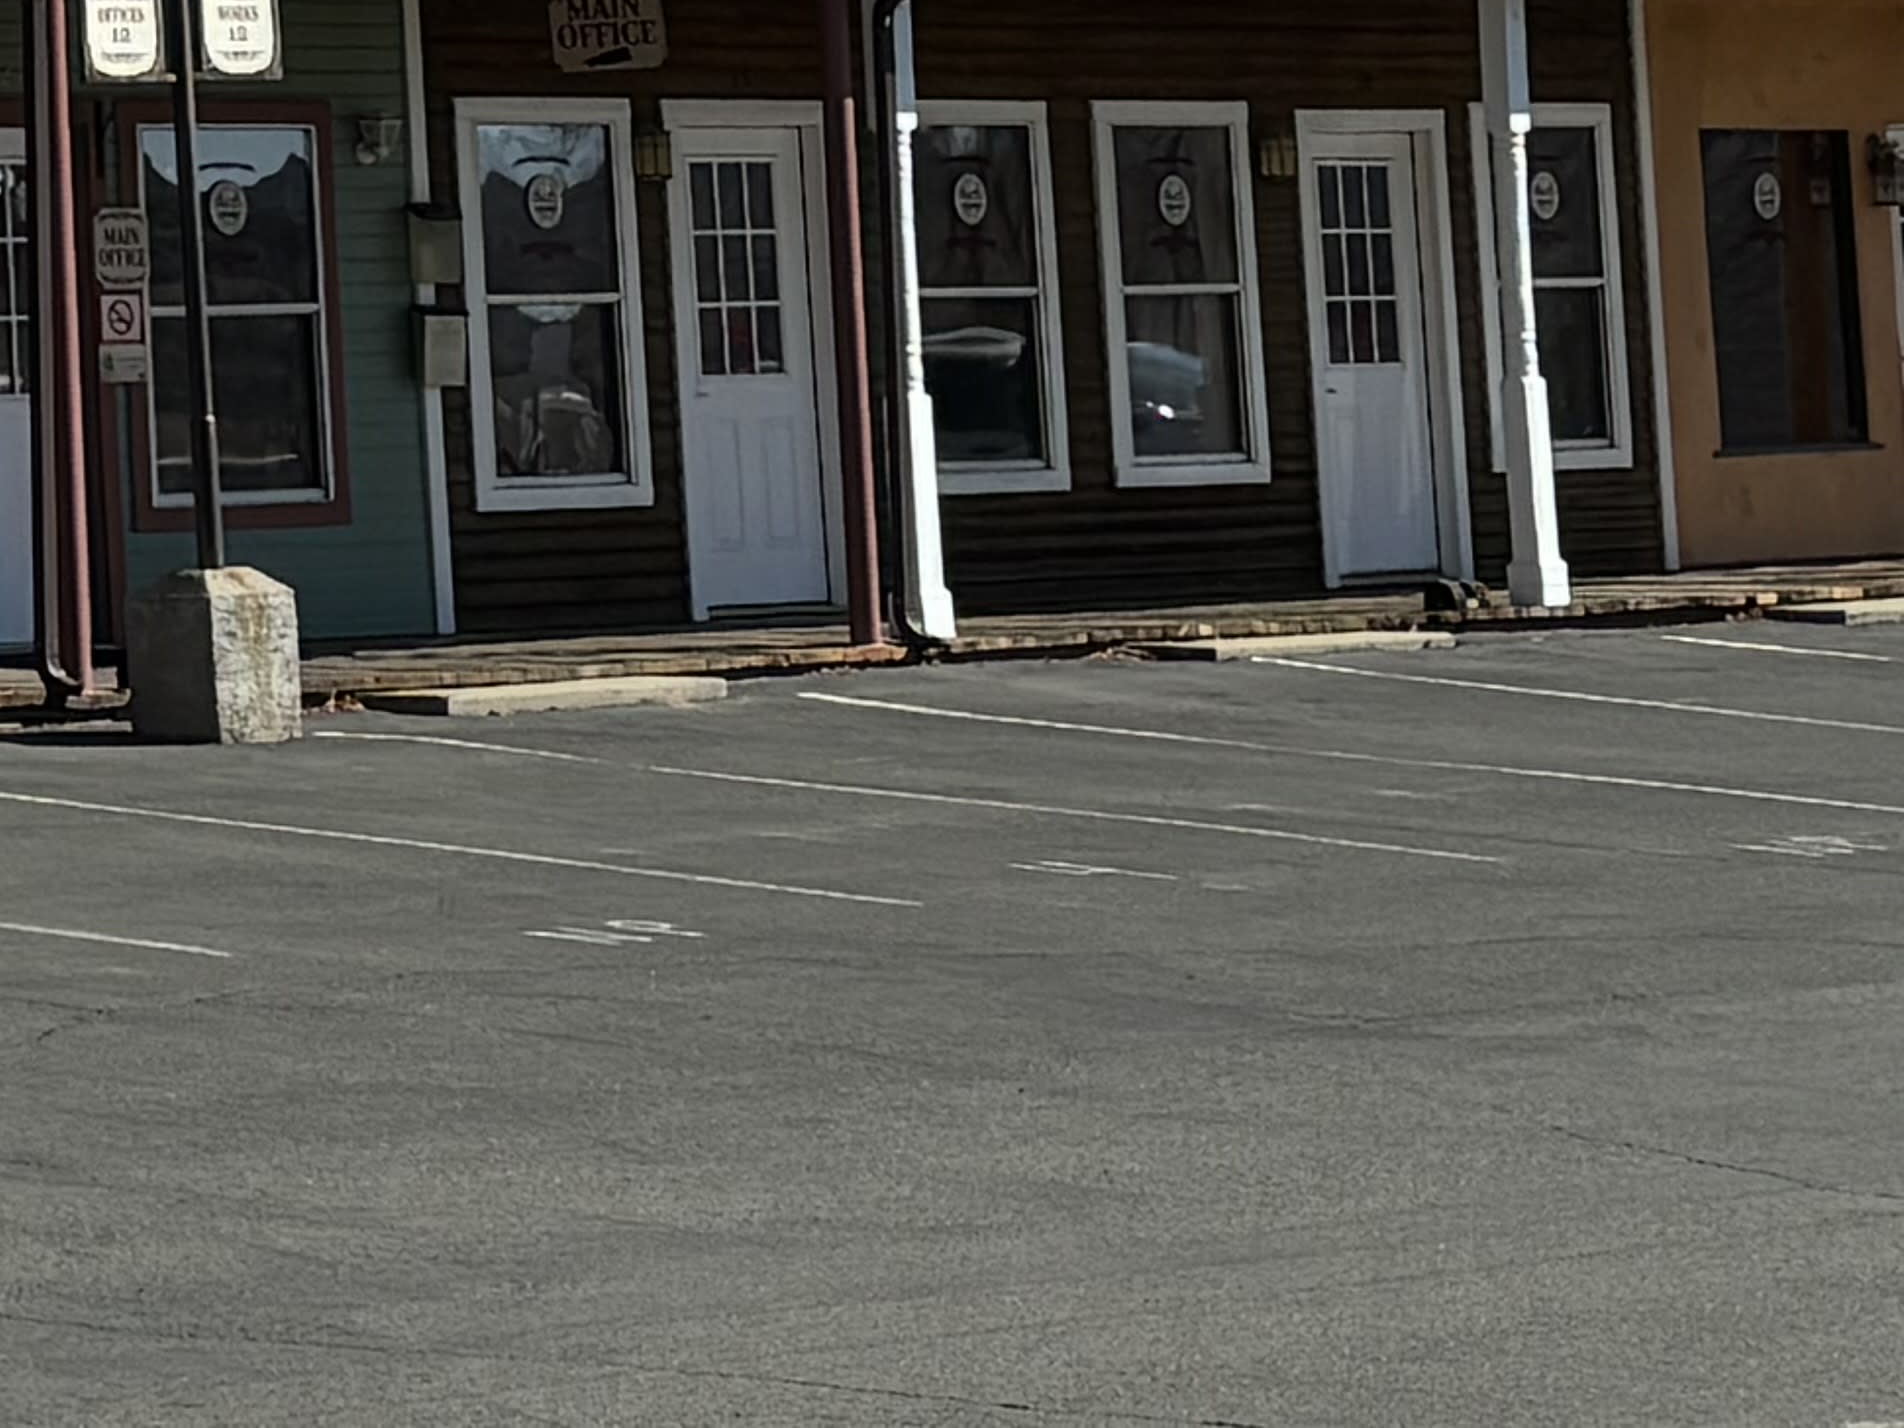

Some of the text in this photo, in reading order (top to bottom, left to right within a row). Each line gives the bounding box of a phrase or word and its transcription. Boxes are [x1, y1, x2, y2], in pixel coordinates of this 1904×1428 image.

[558, 20, 657, 49] OFFICE
[104, 227, 141, 246] MAIN
[99, 248, 146, 267] OFFICE
